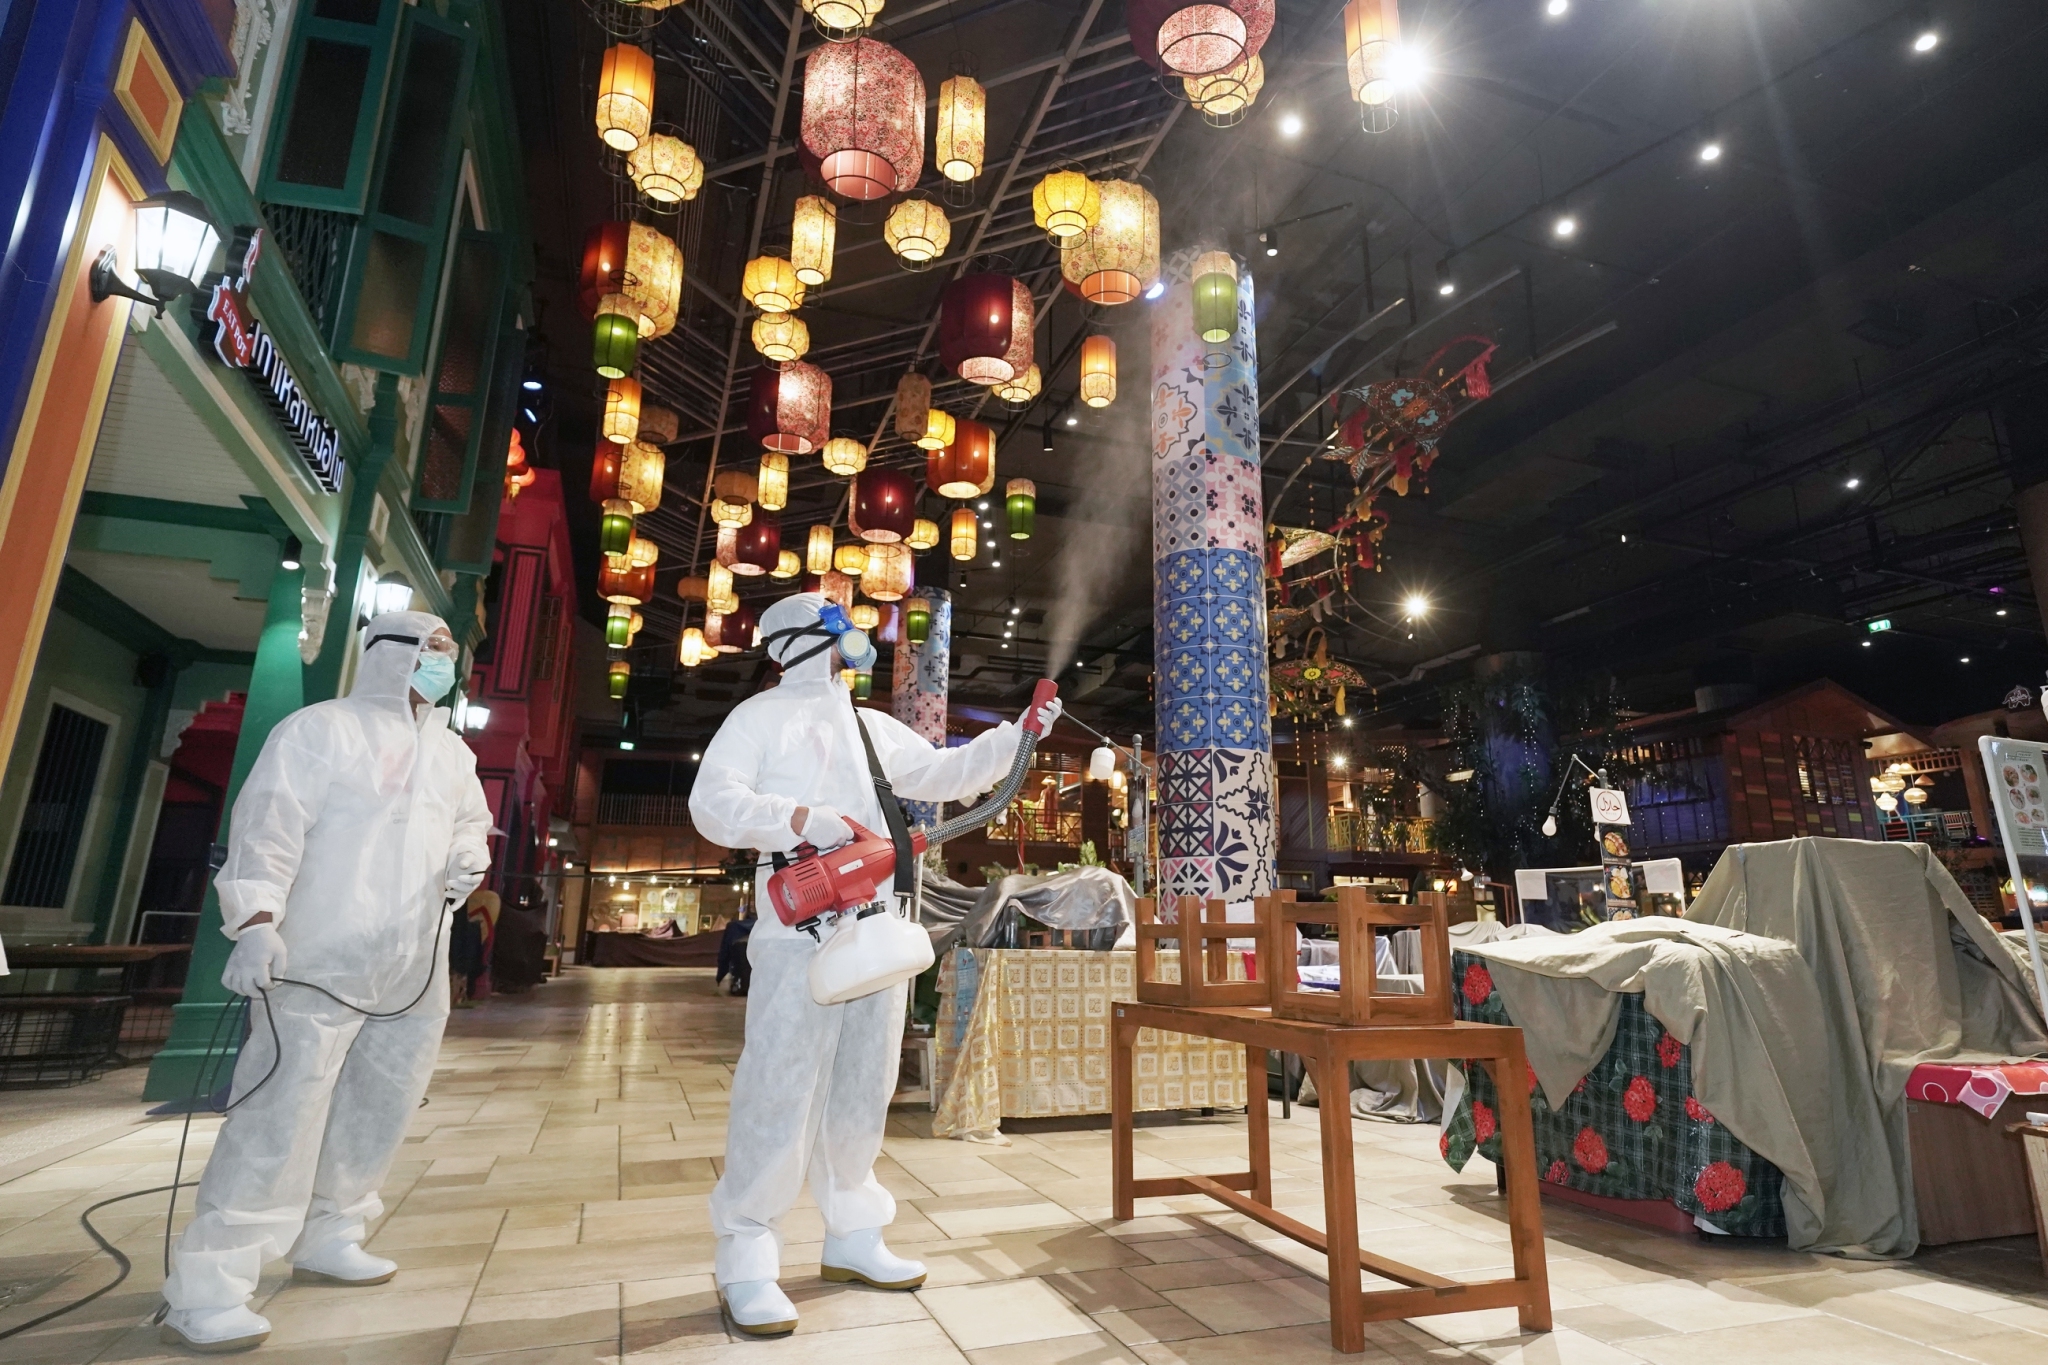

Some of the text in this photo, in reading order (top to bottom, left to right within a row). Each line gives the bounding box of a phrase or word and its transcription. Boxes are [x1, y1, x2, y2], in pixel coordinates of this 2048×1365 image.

[222, 297, 248, 358] EAT POT
[1600, 796, 1621, 812] حلال
